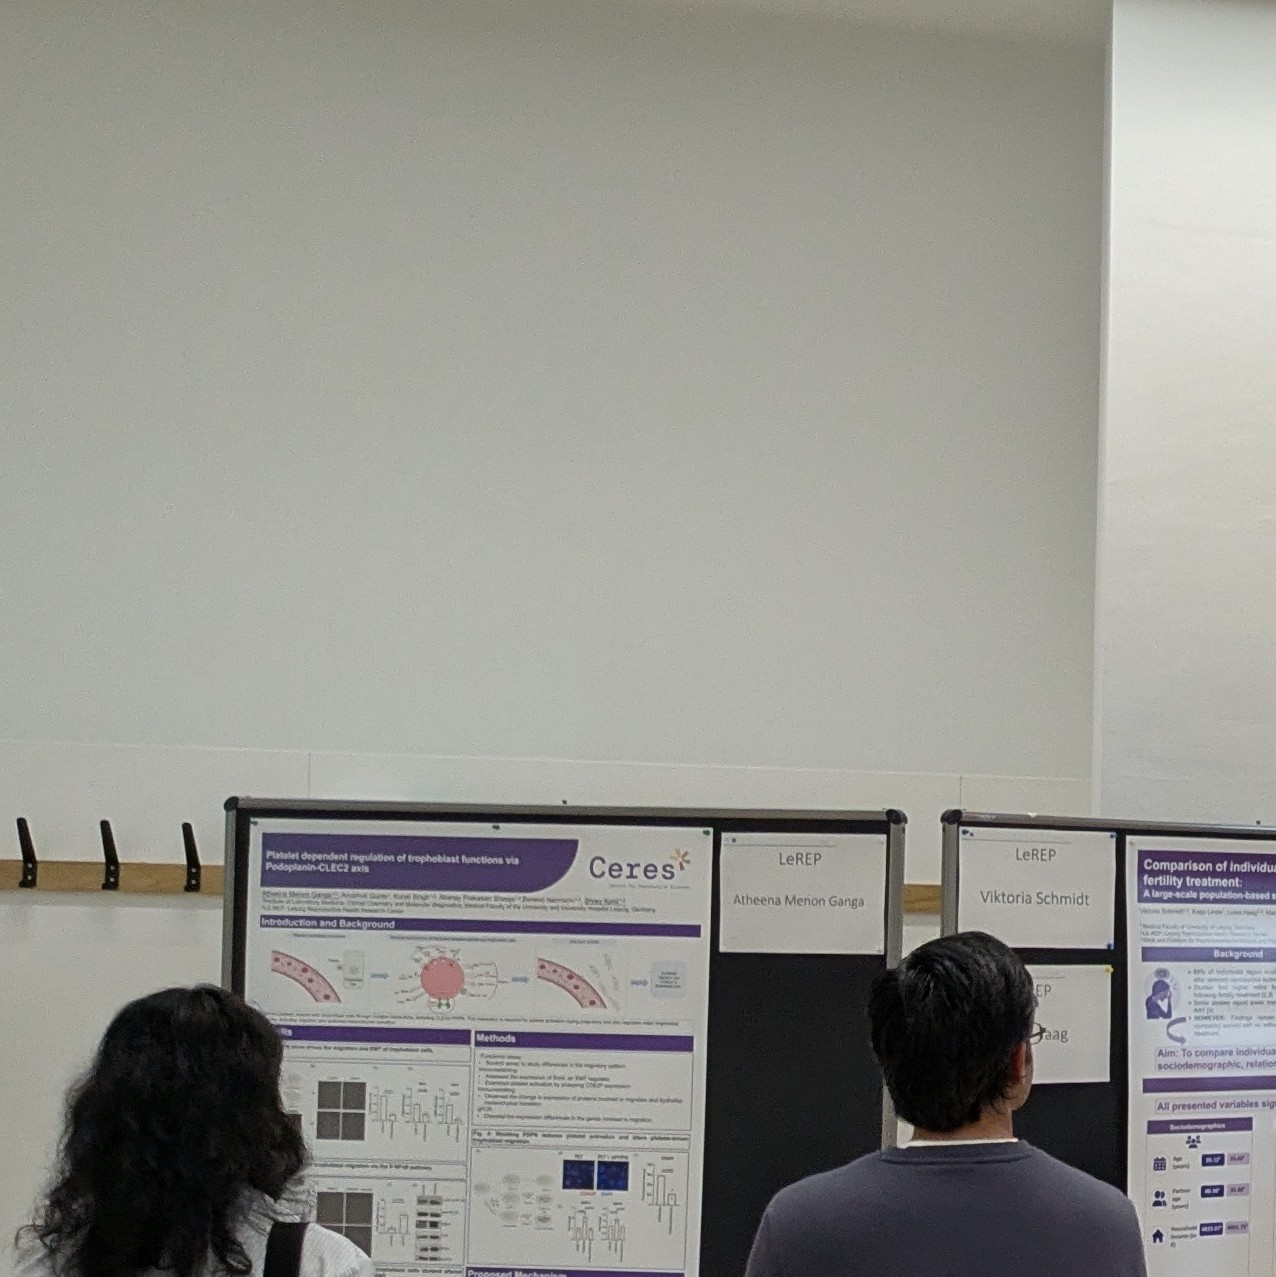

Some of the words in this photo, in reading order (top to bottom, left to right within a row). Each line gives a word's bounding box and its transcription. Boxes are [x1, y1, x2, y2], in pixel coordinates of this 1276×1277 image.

[266, 851, 300, 861] Platelet
[301, 852, 348, 863] dependent
[351, 853, 394, 864] regulation
[397, 853, 406, 862] of
[408, 854, 459, 865] trophoblast
[462, 854, 503, 865] functions
[506, 856, 519, 865] via
[779, 852, 822, 865] LeREP
[1016, 848, 1056, 861] LeREP
[266, 862, 349, 874] Podoplanin-CLEC2
[351, 865, 369, 873] axis
[589, 856, 675, 880] Ceres
[1144, 859, 1214, 874] Comparison
[1216, 860, 1228, 871] of
[1143, 874, 1183, 888] fertility
[1186, 876, 1243, 888] treatment:
[733, 894, 781, 906] Atheena
[785, 896, 825, 907] Menon
[829, 896, 865, 909] Ganga
[980, 890, 1032, 904] Viktoria
[1037, 892, 1090, 906] Schmidt
[1143, 890, 1150, 898] A
[1152, 891, 1198, 901] large-scale
[1200, 891, 1270, 902] population-based
[261, 917, 317, 927] Introduction
[319, 919, 337, 928] and
[339, 919, 396, 930] Background
[1213, 950, 1264, 960] Background
[476, 1034, 516, 1043] Methods
[1157, 1048, 1179, 1058] Aim:
[1181, 1048, 1192, 1057] To
[1194, 1049, 1233, 1059] compare
[1157, 1060, 1244, 1072] sociodemographic,
[1157, 1102, 1169, 1111] All
[1171, 1101, 1218, 1113] presented
[1220, 1099, 1259, 1109] variables
